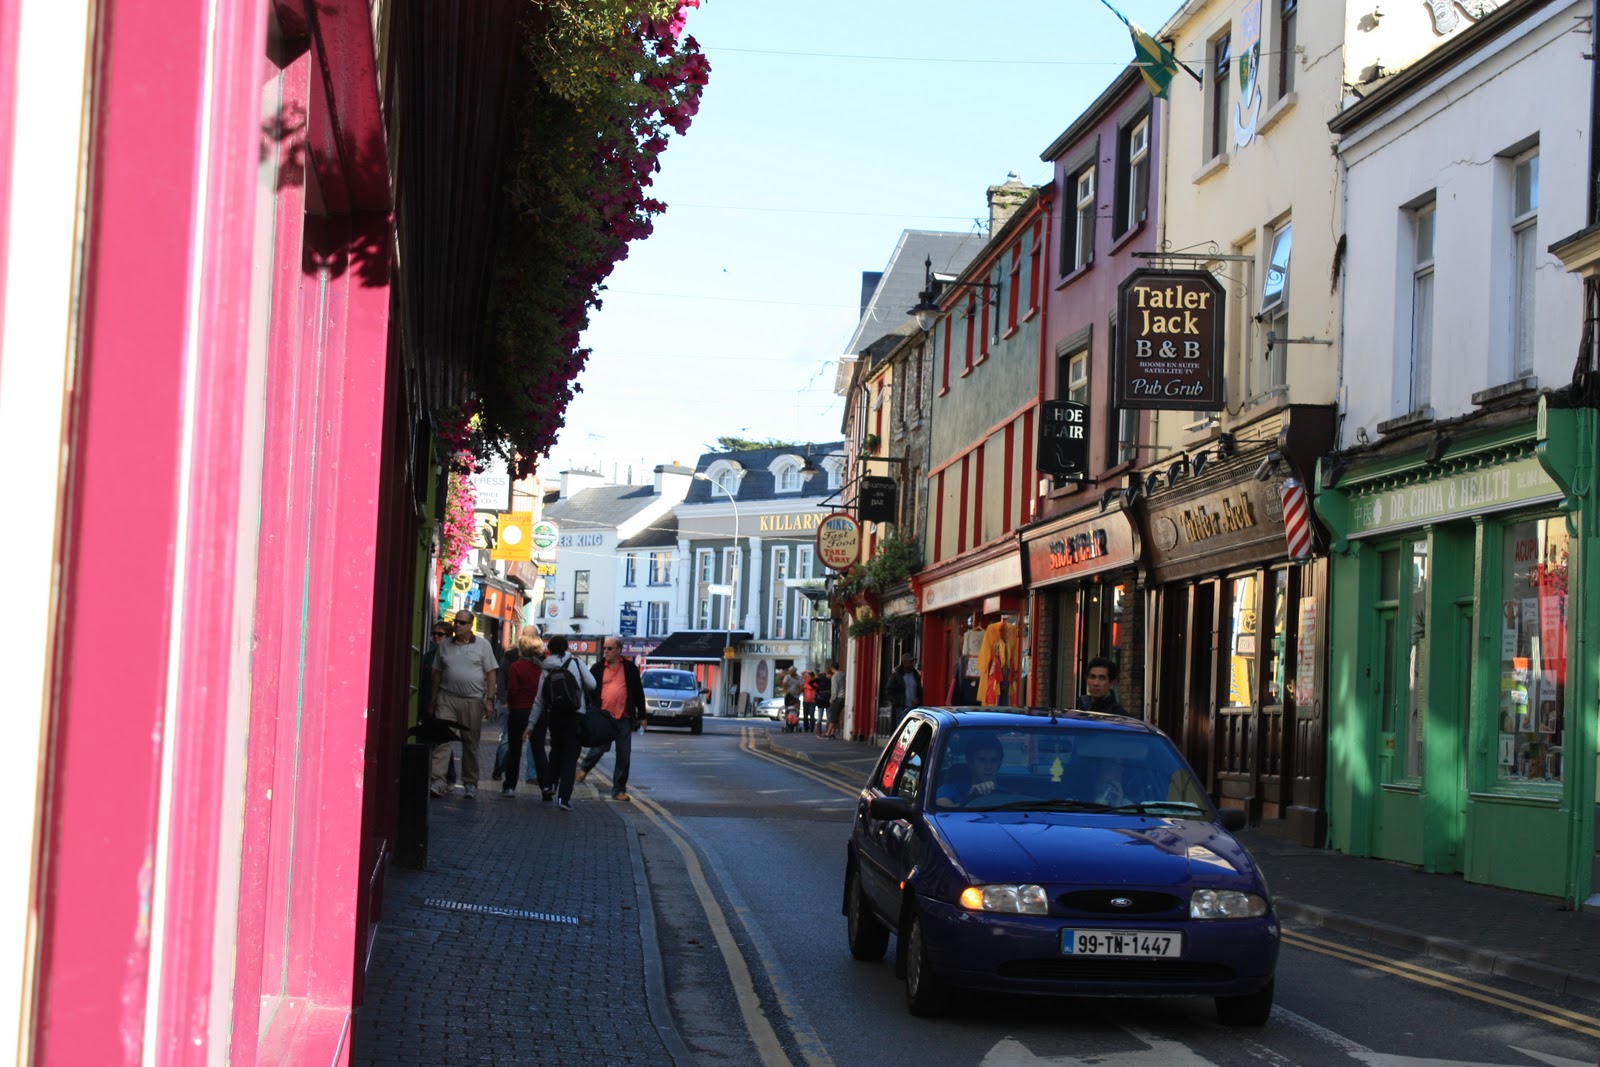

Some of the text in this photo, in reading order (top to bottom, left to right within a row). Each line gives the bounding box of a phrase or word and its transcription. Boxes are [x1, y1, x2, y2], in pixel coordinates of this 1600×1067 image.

[1133, 284, 1211, 310] Tatler
[1141, 309, 1200, 336] Jack
[1135, 339, 1201, 359] B & B
[1131, 378, 1204, 396] Pub Grub
[1046, 407, 1084, 422] SHOE
[468, 476, 506, 486] XPRESS
[1390, 493, 1408, 521] DR.
[1410, 485, 1444, 516] CHINA
[1449, 480, 1457, 509] &
[1460, 469, 1511, 507] HEALTH
[760, 513, 831, 531] KILLARN
[1179, 505, 1218, 543] Tatler
[1222, 492, 1254, 533] Jack
[576, 533, 603, 546] KING
[822, 531, 848, 540] Fast
[826, 538, 856, 548] Food
[824, 548, 847, 556] TAKE
[827, 554, 852, 563] AWAY
[738, 643, 764, 653] PUBLIC
[1077, 935, 1171, 955] 99-TN-1447
